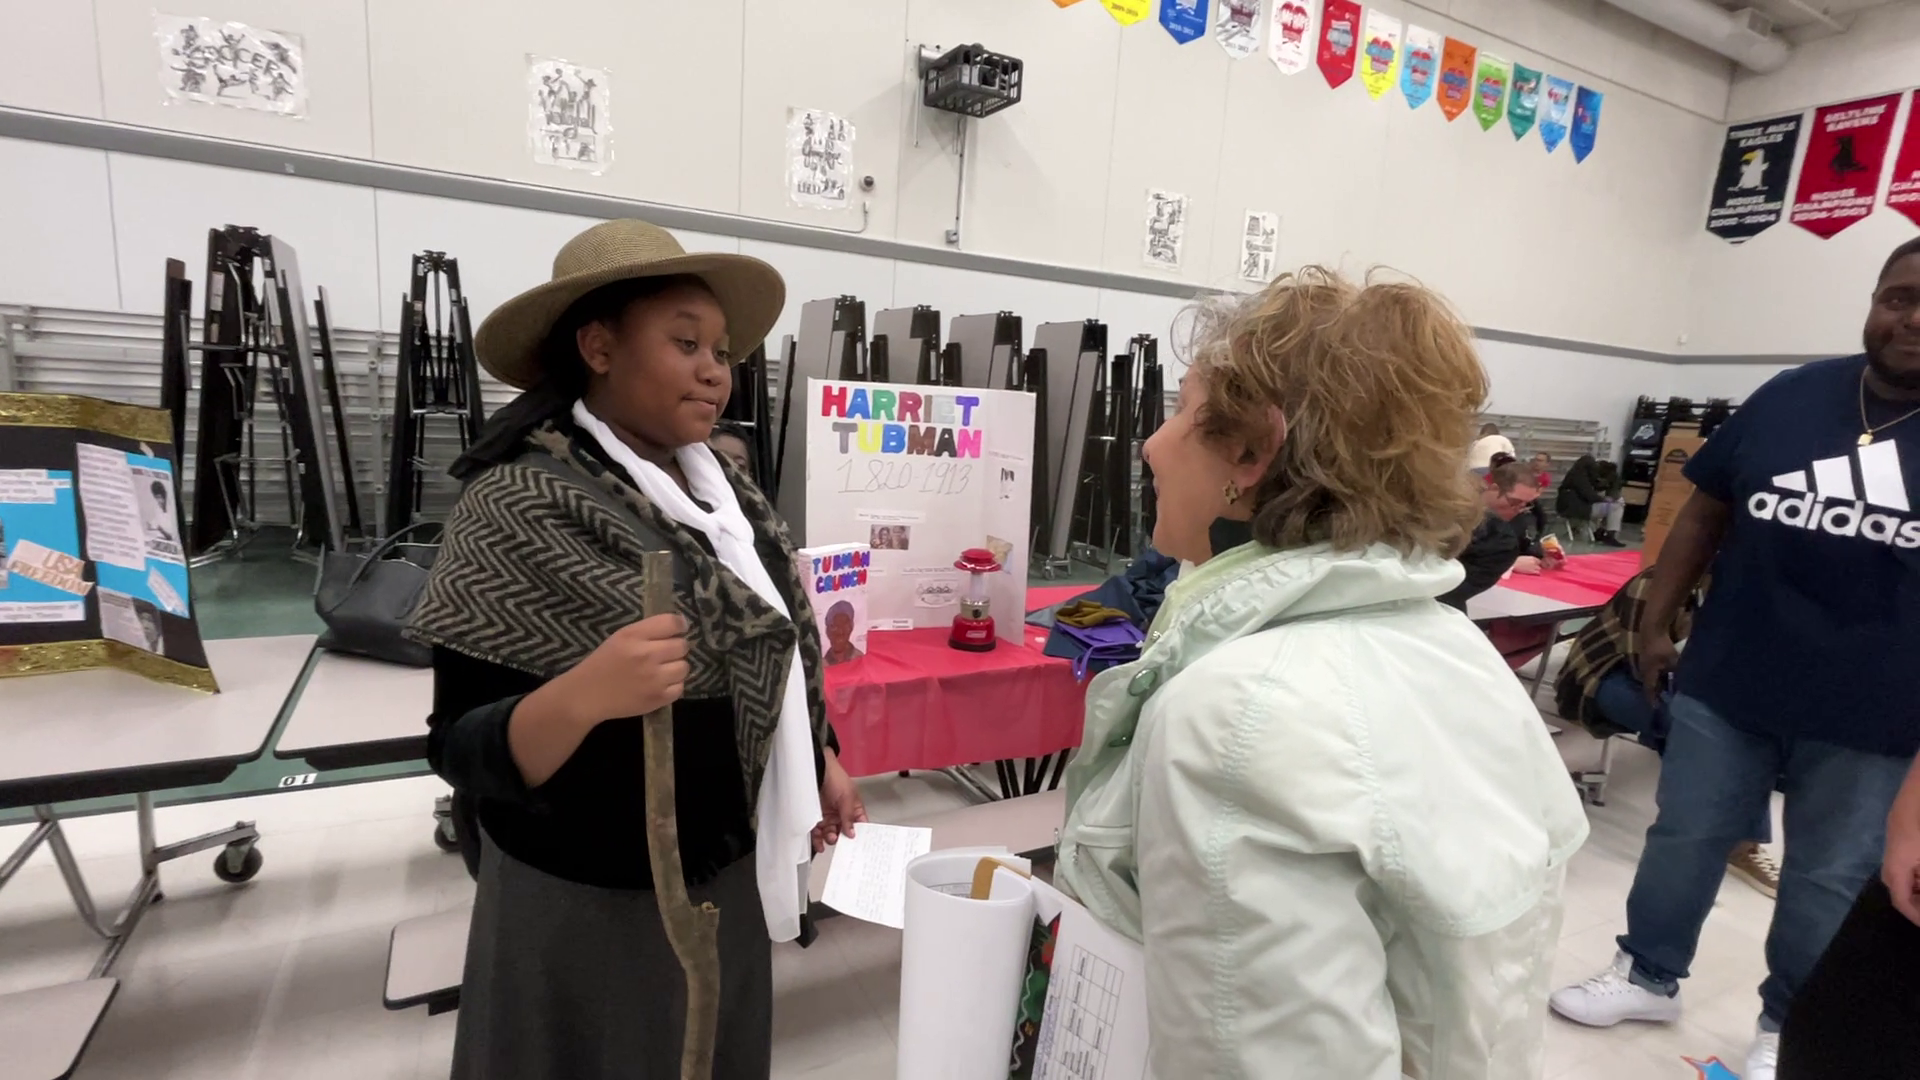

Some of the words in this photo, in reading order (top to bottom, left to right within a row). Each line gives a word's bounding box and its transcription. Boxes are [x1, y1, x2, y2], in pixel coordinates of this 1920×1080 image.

[1711, 201, 1783, 217] CHAMPIONS
[1793, 196, 1875, 212] CHAMPIONS
[821, 385, 980, 427] HARRIET
[832, 422, 983, 459] TUBMAN
[1747, 491, 1920, 549] adidas
[43, 551, 84, 578] USA
[812, 551, 871, 575] TUBMAN
[815, 569, 867, 594] CRUNCH
